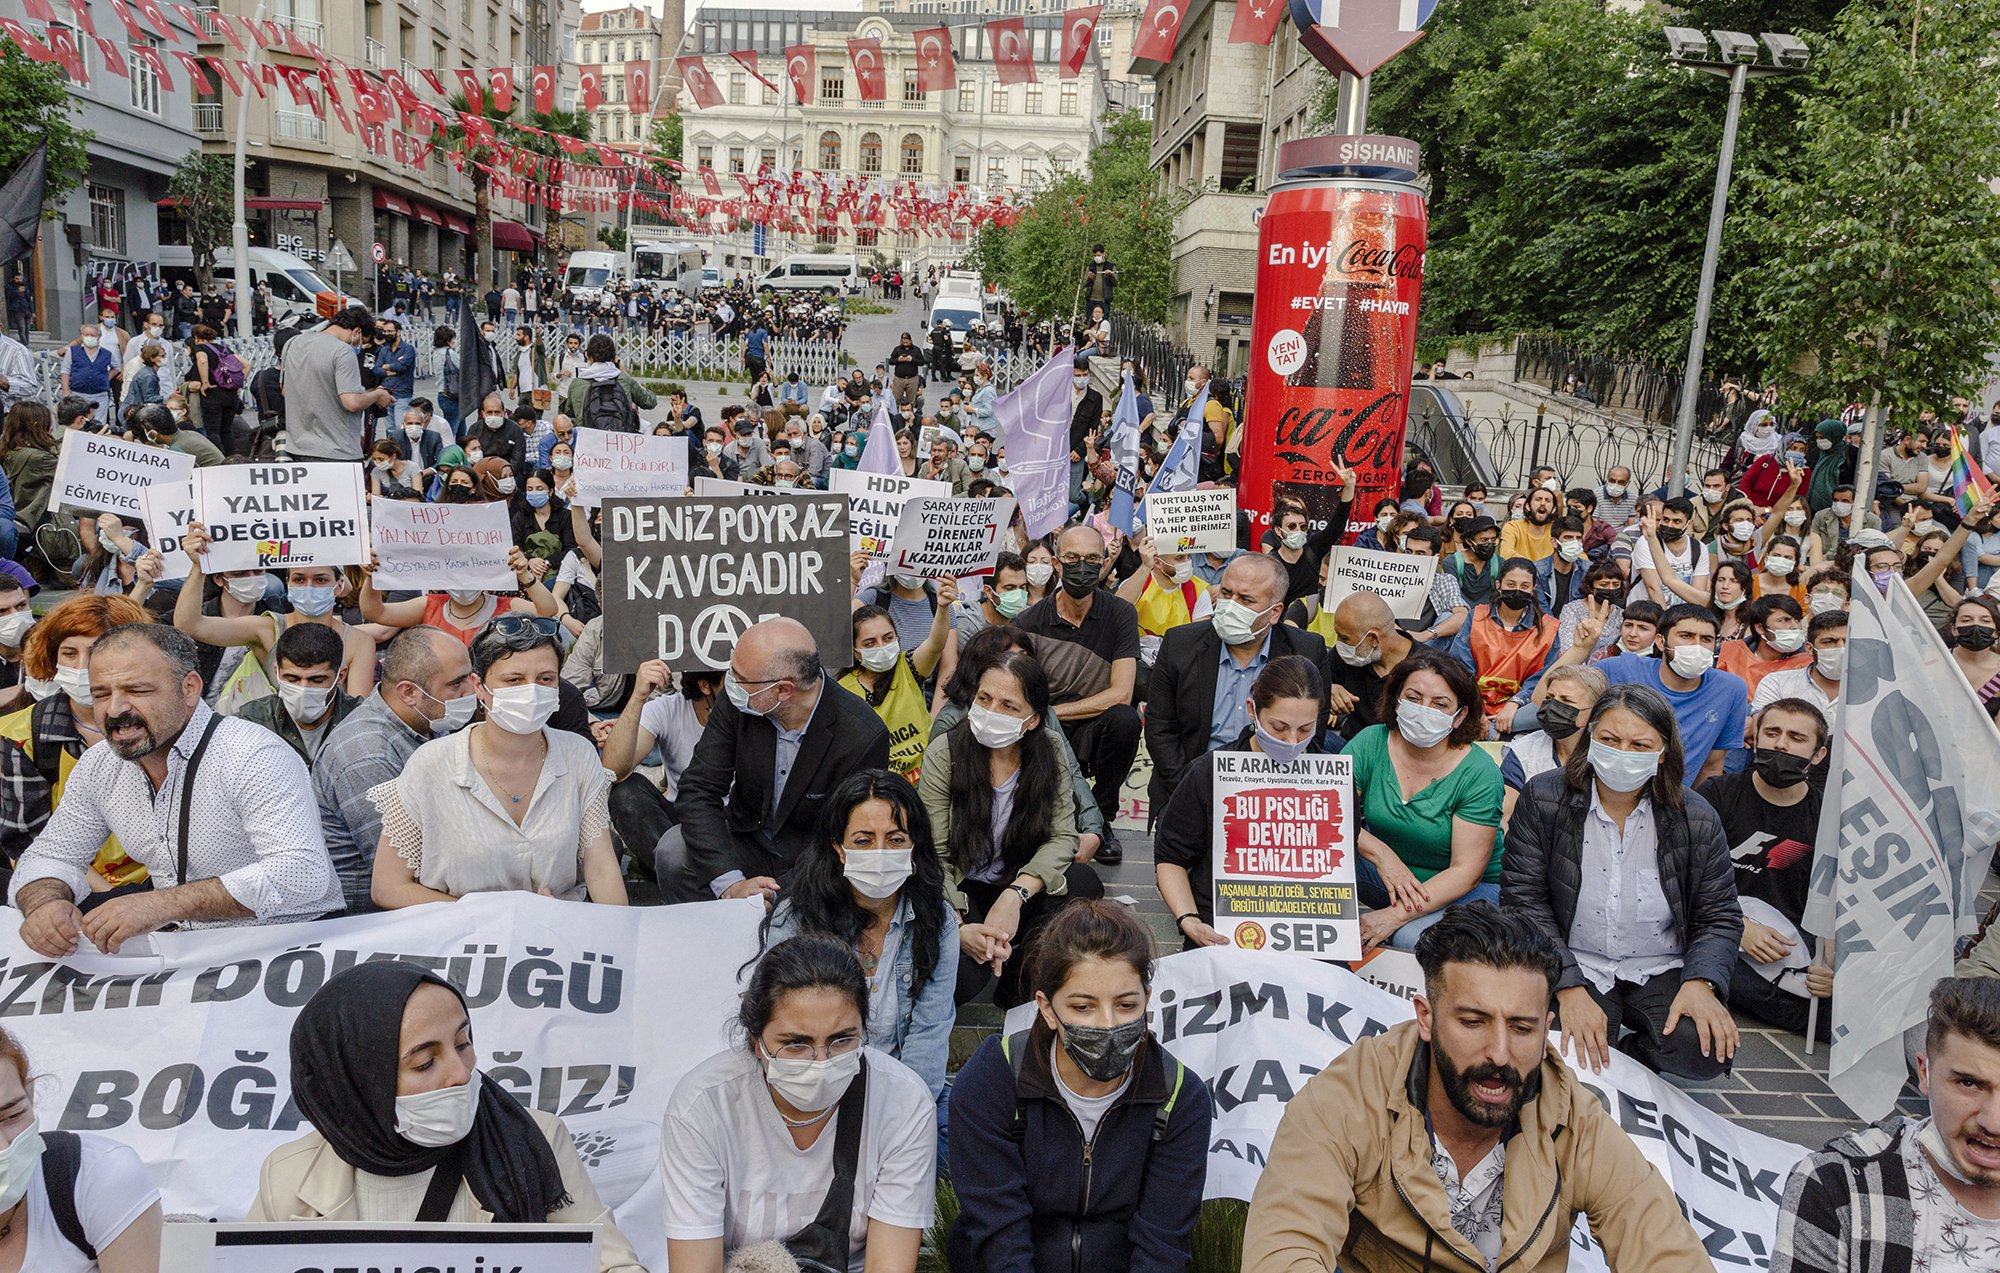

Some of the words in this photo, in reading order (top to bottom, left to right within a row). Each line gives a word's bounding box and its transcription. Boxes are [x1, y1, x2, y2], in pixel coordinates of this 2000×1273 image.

[1339, 139, 1414, 166] ŞİŞHANE
[277, 233, 303, 248] BIG
[1269, 243, 1295, 266] En
[1303, 241, 1333, 269] iyi
[1290, 296, 1347, 310] #EVET
[1358, 299, 1410, 316] #HAYIR
[1271, 336, 1300, 355] YENİ
[1276, 352, 1298, 367] TAT
[606, 433, 645, 454] HDP
[86, 441, 171, 470] BASKILARA
[576, 453, 612, 470] YALNIZ
[95, 467, 152, 488] BOYUN
[250, 466, 308, 486] HDP
[867, 476, 911, 495] HDP
[1292, 468, 1337, 482] ZERO
[1354, 473, 1388, 484] UGAR
[64, 484, 142, 511] EĞMEYEC
[223, 493, 330, 514] YALNIZ
[849, 497, 905, 518] YALN
[922, 501, 962, 512] SARAY
[963, 499, 996, 514] REJİMİ
[1152, 495, 1207, 505] KURTULUŞ
[1209, 493, 1230, 502] YOK
[411, 506, 451, 525] HDP
[920, 512, 994, 526] YENİLECEK
[1152, 517, 1165, 525] YA
[1167, 515, 1186, 524] HEP
[1189, 513, 1232, 523] BERABER
[1161, 506, 1182, 514] TEK
[1184, 504, 1221, 514] BAŞINA
[209, 516, 355, 542] DEĞİLDİR!
[376, 524, 431, 544] YALNIZ
[611, 504, 715, 543] DENİZ
[719, 503, 844, 545] POYRAZ
[849, 518, 898, 540] EĞİL
[927, 526, 985, 541] DİRENEN
[1170, 524, 1188, 534] HİÇ
[1190, 522, 1231, 532] BİRİMİZ!
[924, 541, 983, 553] HALKLAR
[908, 551, 990, 566] KAZANACAK!
[1347, 556, 1420, 574] KATİLLERDEN
[625, 551, 824, 600] KAVGADIR
[1337, 567, 1377, 582] HESABI
[1379, 574, 1425, 588] GENÇLİK
[1217, 757, 1237, 773] NE
[1240, 758, 1312, 775] ARARSAN
[1315, 760, 1350, 776] VAR!
[1236, 796, 1260, 820] BU
[1248, 822, 1317, 847] DEVRİM
[1235, 848, 1333, 873] TEMİZLER!
[1218, 884, 1269, 899] YAŞANANLAR
[1269, 883, 1284, 897] DİZİ
[1285, 885, 1309, 900] DEĞİL,
[1309, 886, 1353, 900] SEYRETME!
[1230, 899, 1265, 914] ÖRGÜTLÜ
[1266, 899, 1317, 915] MÜCADELEYE
[1317, 903, 1342, 915] KATIL!
[1269, 922, 1338, 952] SEP
[1148, 981, 1290, 1044] İZM
